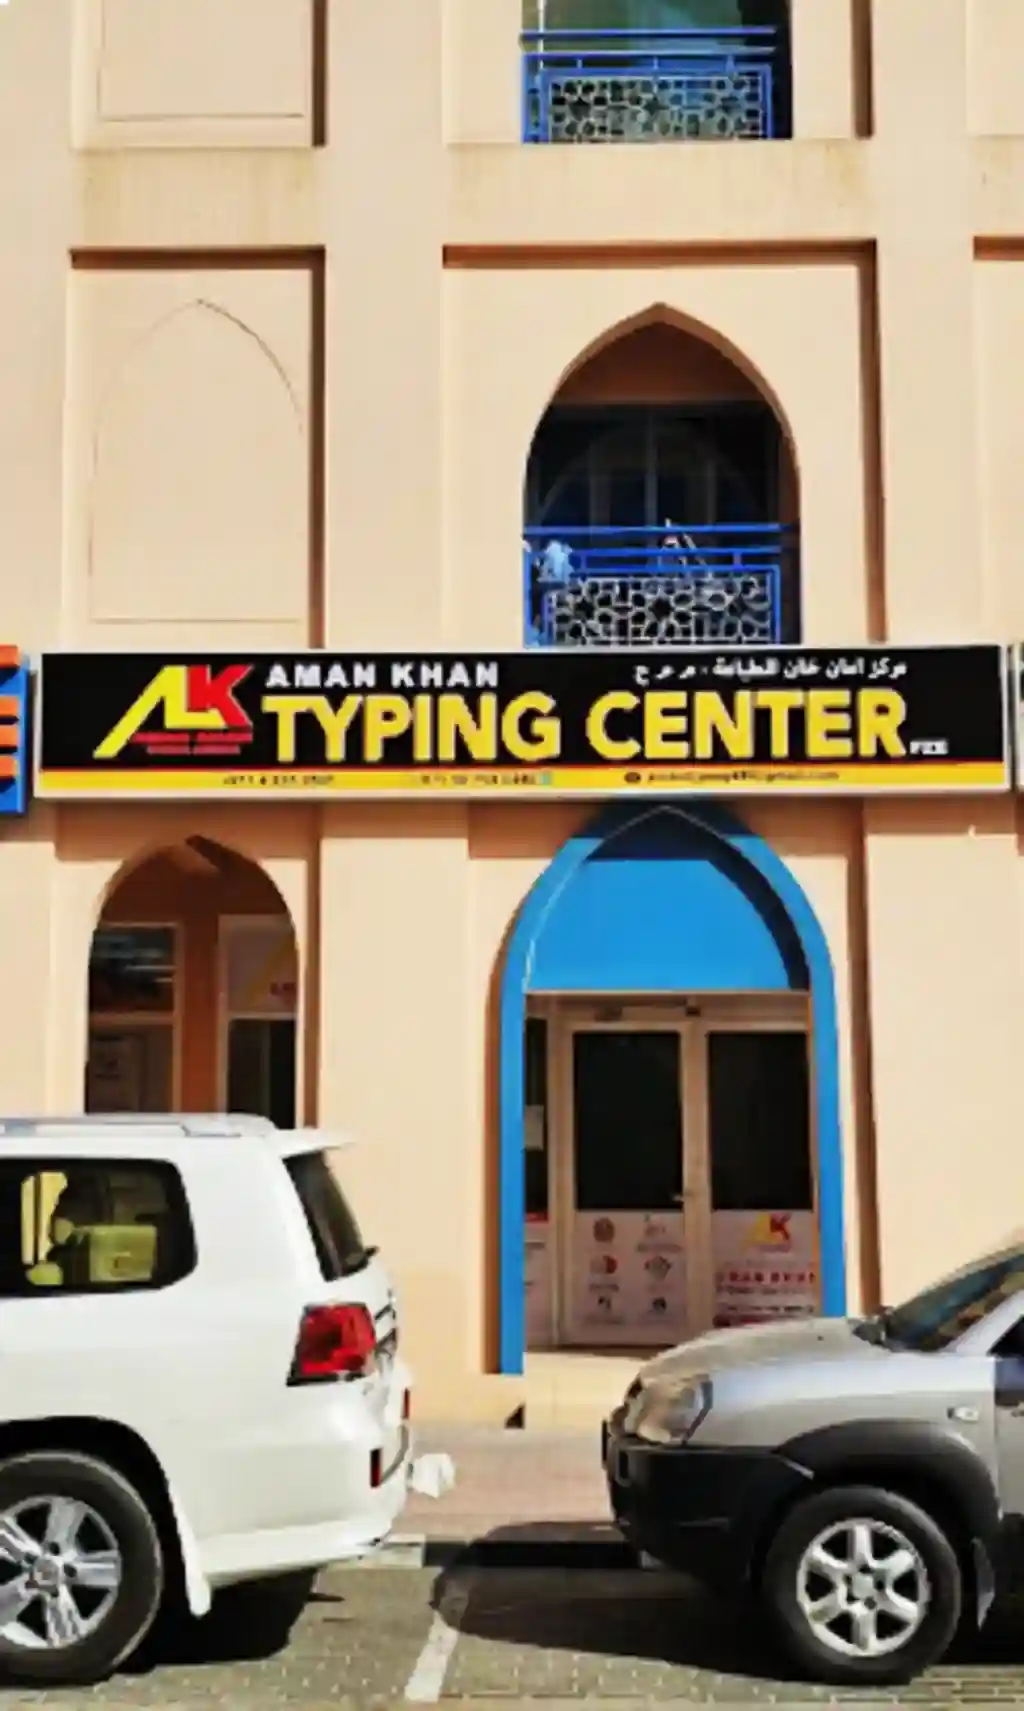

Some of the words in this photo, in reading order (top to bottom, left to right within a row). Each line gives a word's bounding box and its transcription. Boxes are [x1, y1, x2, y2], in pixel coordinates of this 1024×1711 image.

[265, 662, 376, 689] AMAN
[390, 662, 498, 689] KHAN
[261, 692, 561, 763] TYPING
[586, 688, 907, 761] CENTER
